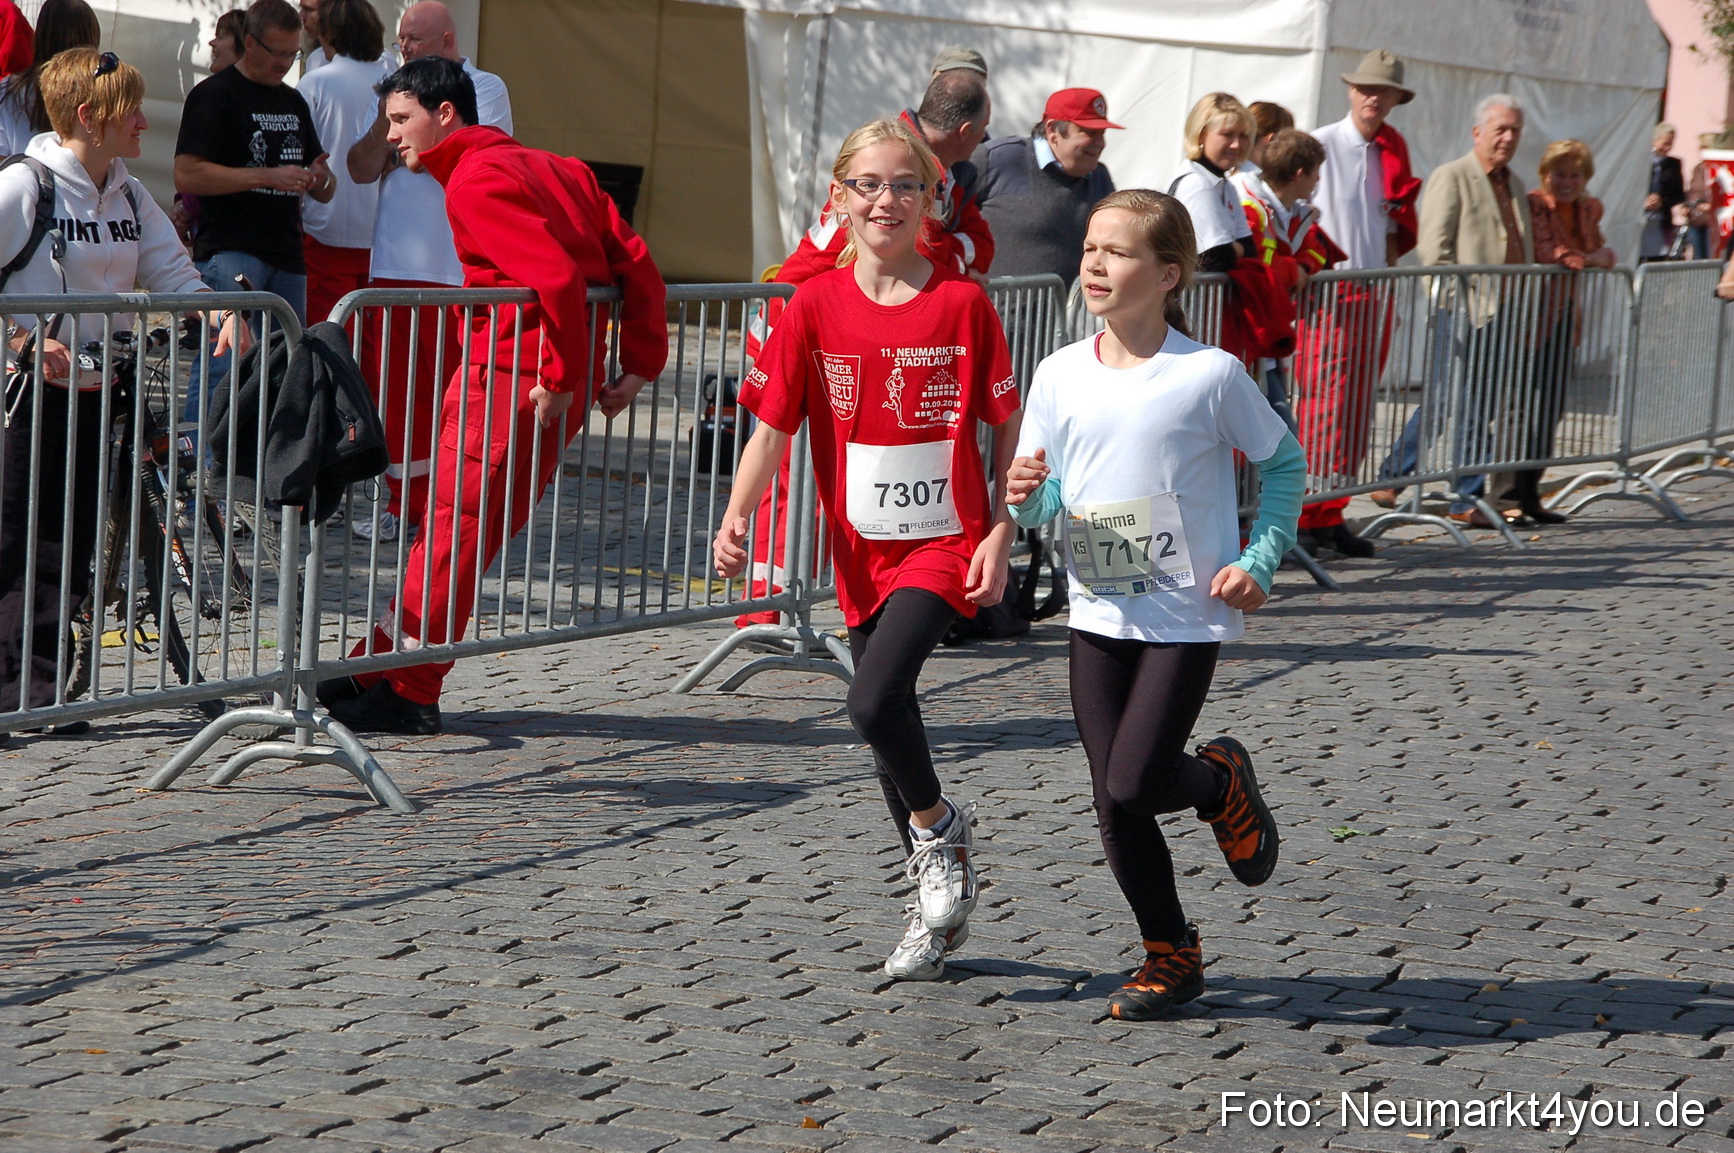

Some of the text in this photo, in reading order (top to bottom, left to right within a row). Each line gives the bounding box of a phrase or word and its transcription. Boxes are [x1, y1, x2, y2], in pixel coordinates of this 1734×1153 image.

[260, 122, 299, 131] STADTLAUF
[880, 345, 967, 358] 11. NEUMARKTER
[893, 355, 954, 368] STADTLAUF
[827, 380, 853, 400] NEU
[830, 395, 854, 411] MARKT
[874, 477, 949, 508] 7307
[910, 518, 951, 530] PFLEIDERER
[1090, 512, 1137, 530] Emma
[1072, 541, 1087, 555] K5
[1098, 531, 1177, 566] 7172
[1146, 571, 1192, 587] PFLEIDERER
